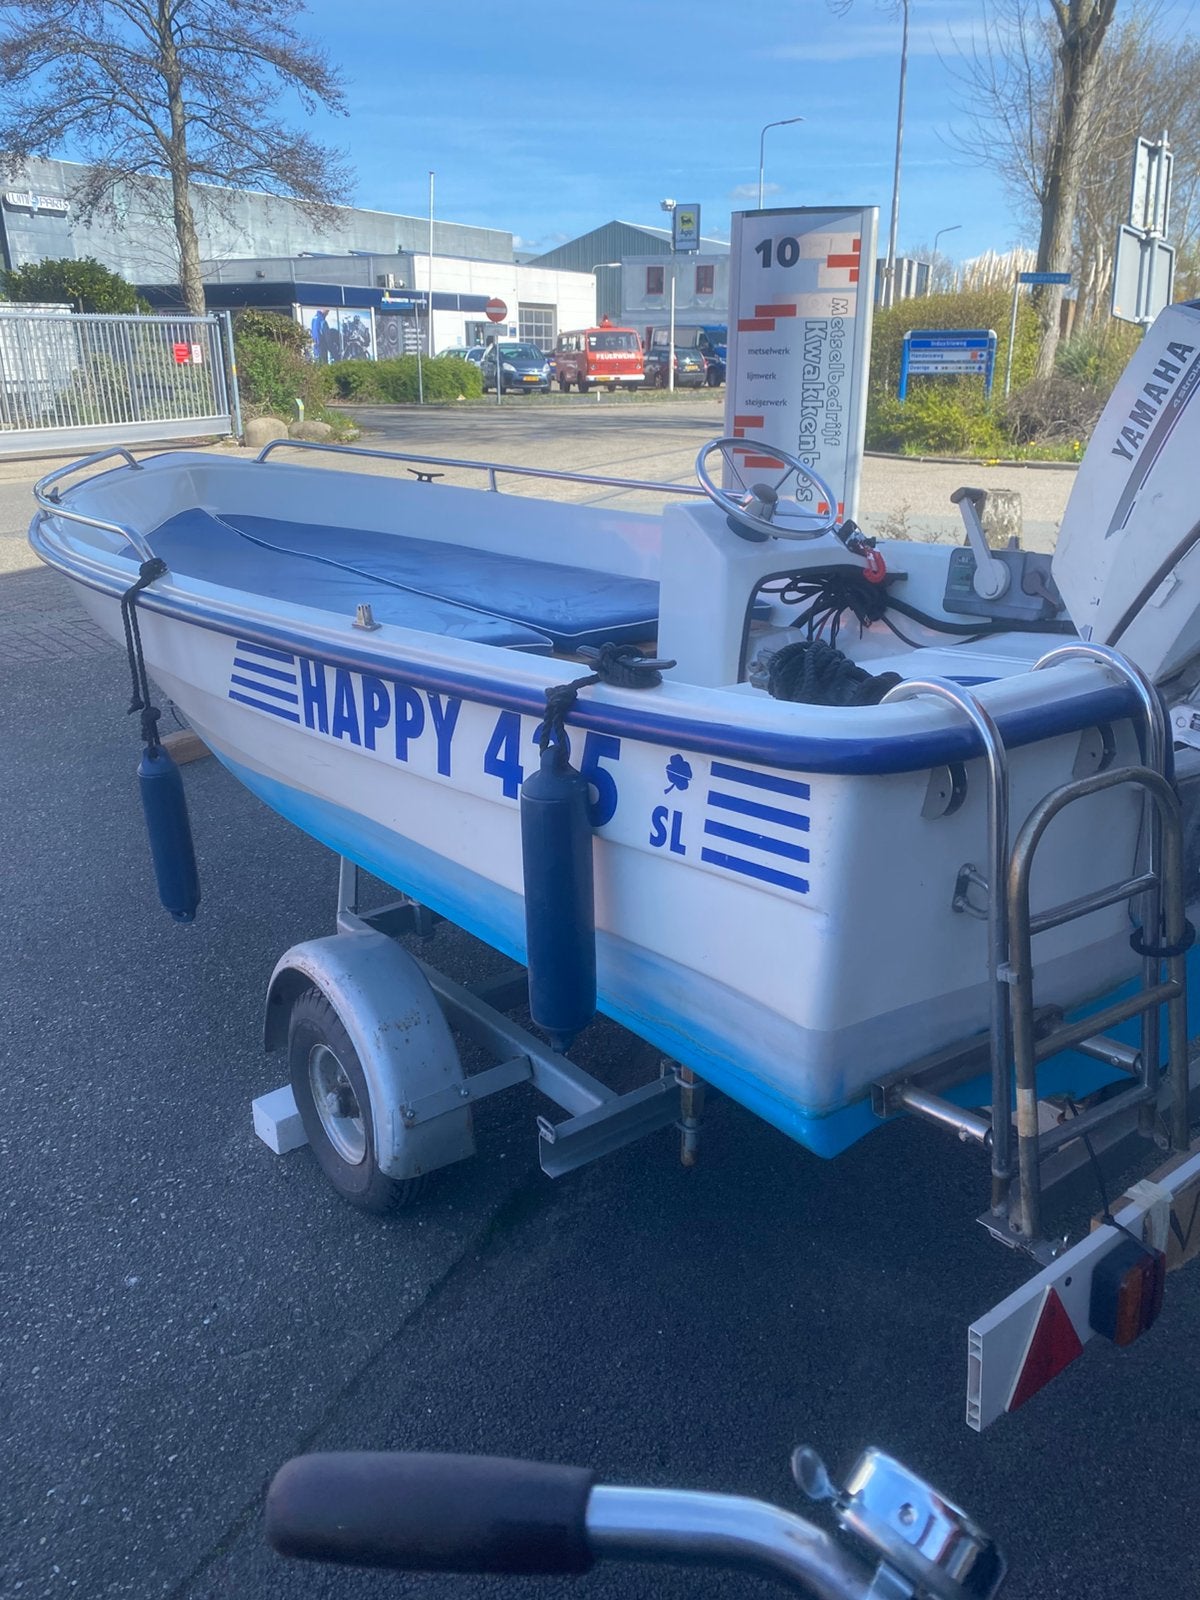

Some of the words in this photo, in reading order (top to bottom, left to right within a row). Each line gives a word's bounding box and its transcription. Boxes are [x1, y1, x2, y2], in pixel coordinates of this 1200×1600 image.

[755, 236, 800, 269] 10
[746, 372, 777, 381] lijmwerk
[747, 347, 790, 355] metselwerk
[821, 297, 849, 446] Metselbedrijf
[745, 399, 788, 408] steigerwerk
[796, 320, 828, 502] Kwakkenbos
[1111, 341, 1195, 462] YAMAHA
[299, 656, 463, 778] HAPPY
[483, 710, 622, 828] 45
[649, 805, 686, 856] SL
